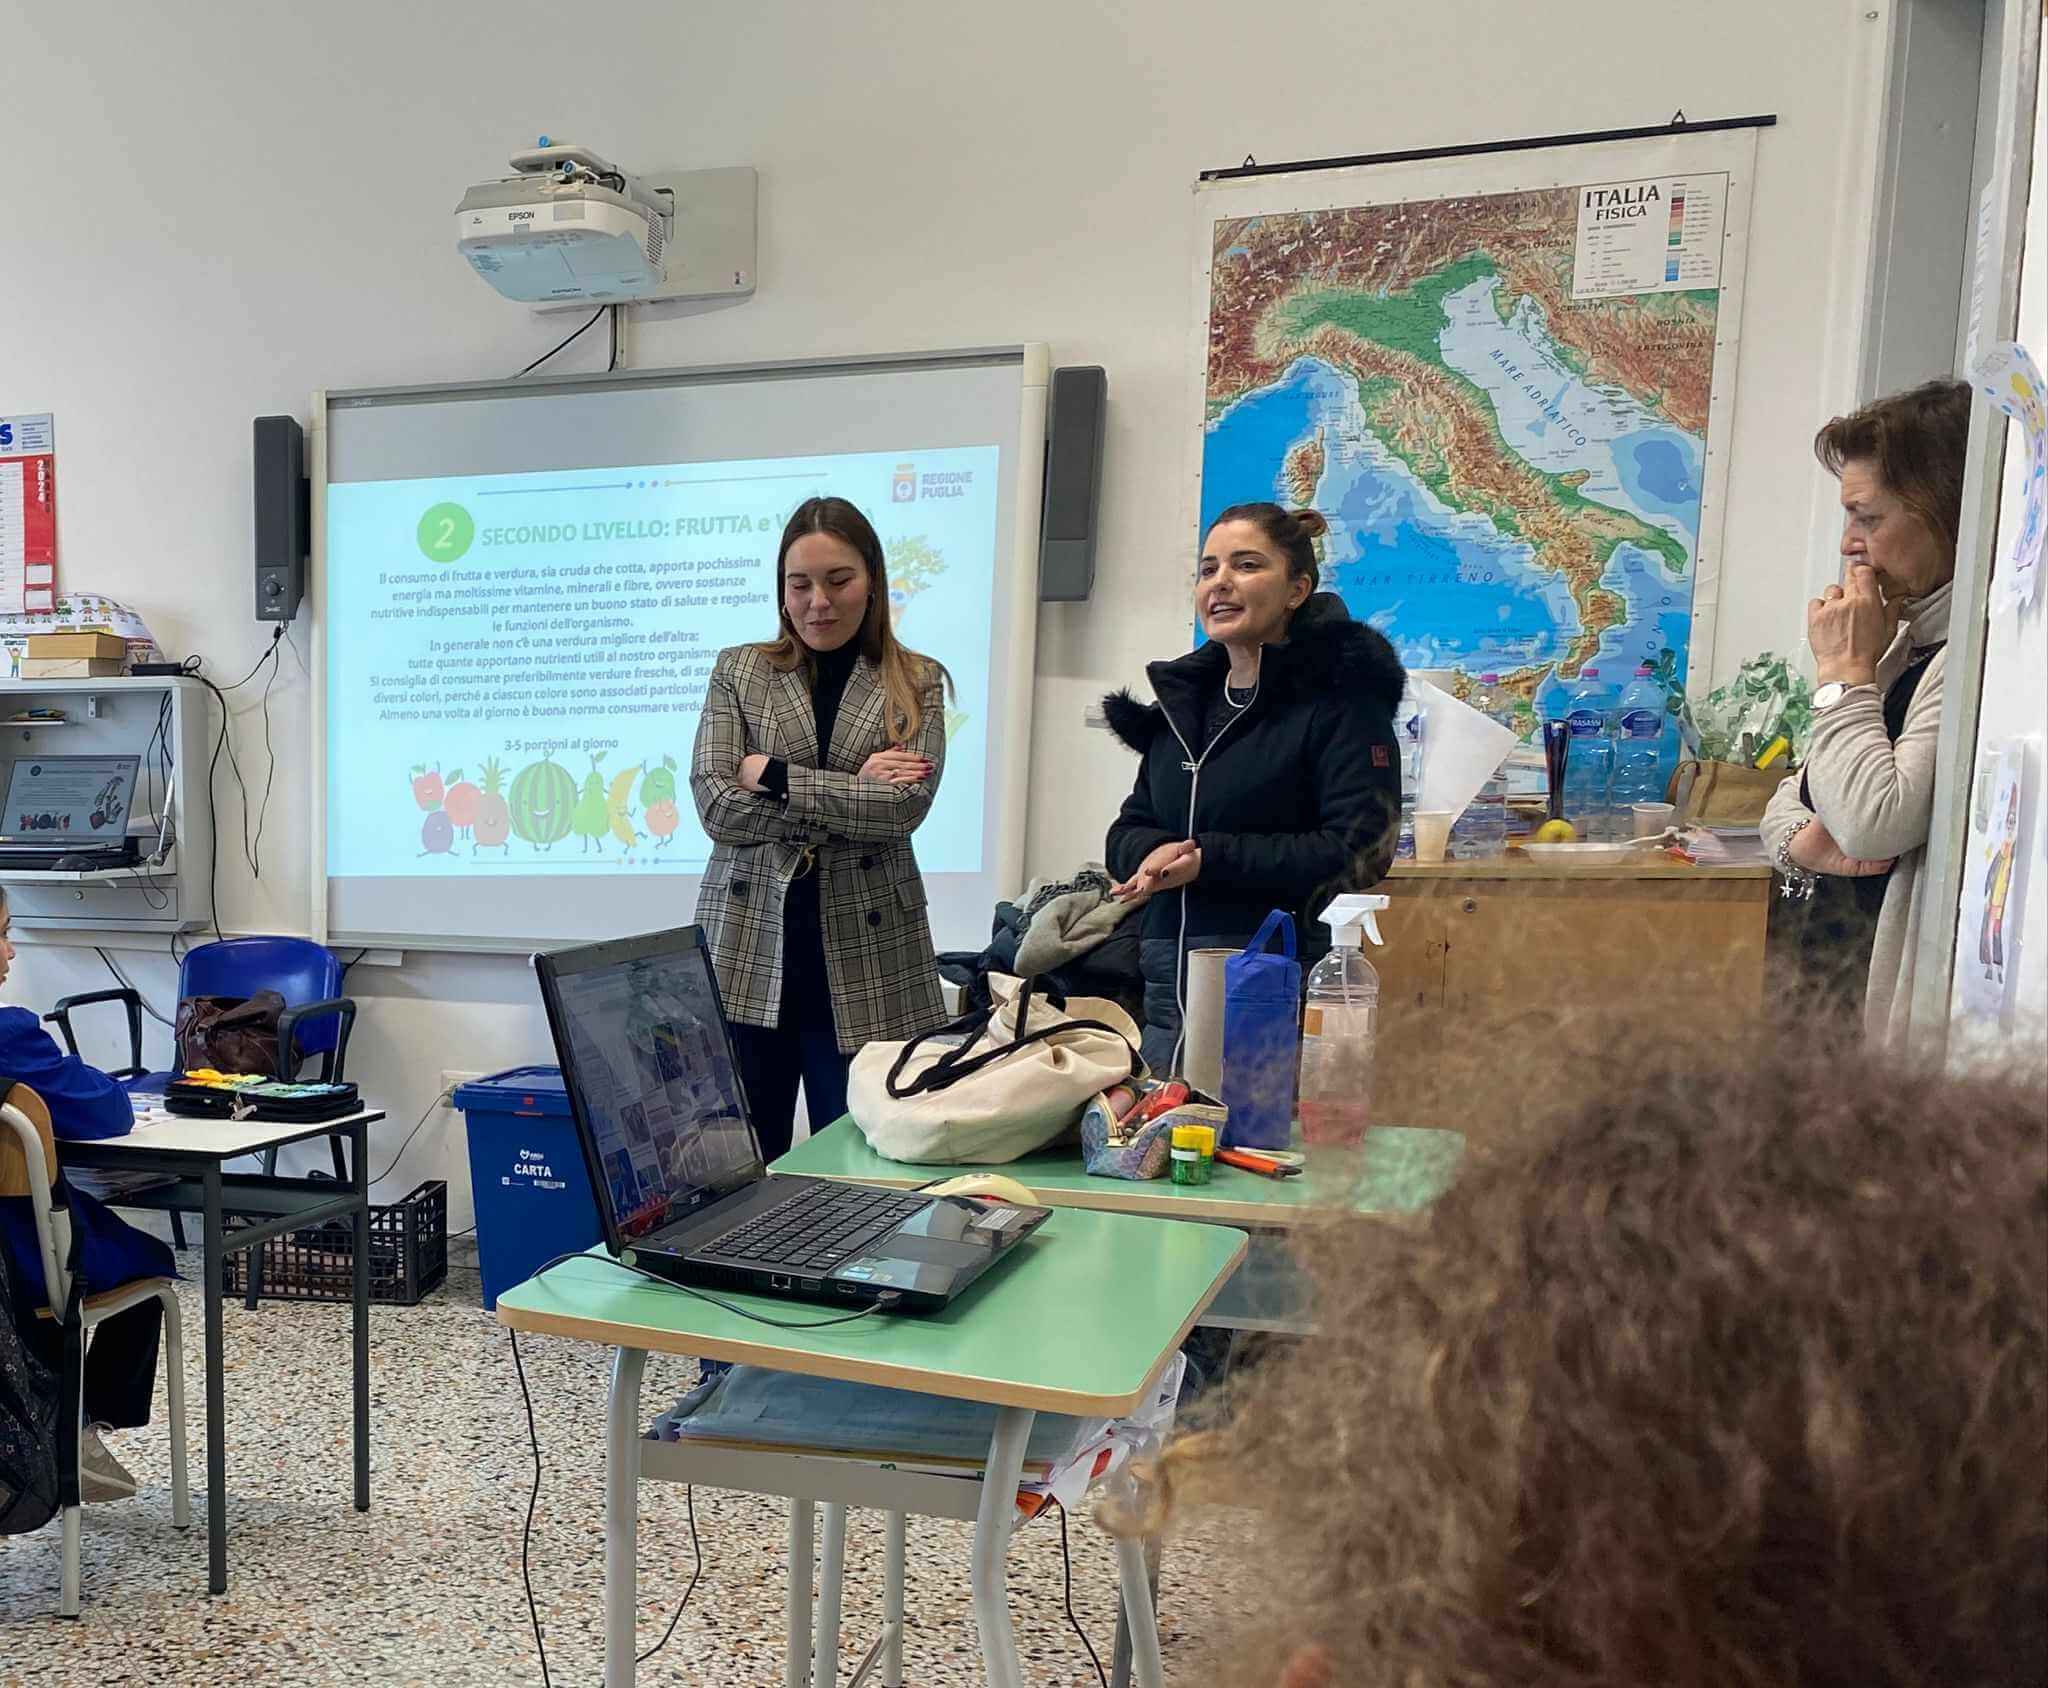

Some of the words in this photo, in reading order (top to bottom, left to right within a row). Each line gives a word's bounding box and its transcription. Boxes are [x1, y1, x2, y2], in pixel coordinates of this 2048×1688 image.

[1585, 185, 1660, 208] ITALIA
[508, 211, 535, 221] EPSON
[1596, 206, 1647, 221] FISICA
[1488, 349, 1525, 382] MARE
[1522, 384, 1587, 448] ADRIATICO
[922, 471, 973, 486] REGIONE
[921, 485, 964, 499] PUGLIA
[436, 518, 455, 548] 2
[481, 522, 577, 547] SECONDO
[583, 519, 669, 541] LIVELLO:
[675, 514, 753, 536] FRUTTA
[758, 518, 770, 532] e
[389, 573, 437, 584] consumo
[439, 571, 450, 582] di
[452, 570, 482, 582] frutta
[494, 568, 538, 580] verdura,
[541, 566, 557, 578] sia
[559, 564, 590, 576] cruda
[593, 563, 612, 575] che
[616, 562, 647, 575] cotta,
[649, 560, 694, 575] apporta
[697, 556, 761, 572] pochissima
[392, 590, 432, 602] energia
[434, 590, 452, 600] ma
[454, 585, 512, 598] moltissime
[514, 584, 564, 596] vitamine,
[567, 580, 612, 594] minerali
[624, 578, 652, 592] fibre,
[655, 578, 692, 590] ovvero
[696, 576, 746, 588] sostanze
[370, 605, 414, 618] nutritive
[416, 604, 489, 619] indispensabili
[491, 604, 510, 617] per
[512, 602, 572, 614] mantenere
[574, 601, 588, 612] un
[592, 599, 627, 610] buono
[630, 596, 658, 609] stato
[661, 594, 672, 608] di
[674, 593, 709, 606] salute
[720, 592, 769, 607] regolare
[493, 621, 502, 632] le
[505, 619, 548, 632] funzioni
[430, 640, 441, 652] In
[444, 638, 490, 653] generale
[493, 640, 514, 650] non
[532, 638, 553, 648] una
[555, 634, 598, 648] verdura
[601, 632, 646, 648] migliore
[408, 658, 434, 670] tutte
[436, 658, 474, 672] quante
[476, 656, 532, 670] apportano
[534, 652, 582, 666] nutrienti
[584, 650, 606, 663] utili
[607, 650, 617, 662] al
[620, 650, 655, 662] nostro
[370, 675, 380, 687] Si
[382, 675, 427, 688] consiglia
[429, 674, 440, 685] di
[442, 674, 500, 685] consumare
[503, 670, 586, 686] preferibilmente
[589, 667, 631, 680] verdure
[634, 666, 678, 680] fresche,
[680, 665, 692, 676] di
[374, 690, 408, 703] diversi
[444, 689, 480, 704] perché
[492, 690, 532, 701] ciascun
[534, 688, 568, 698] colore
[570, 686, 596, 698] sono
[600, 684, 648, 697] associati
[379, 709, 420, 720] Almeno
[422, 710, 442, 720] una
[444, 707, 470, 719] volta
[472, 706, 483, 718] al
[485, 706, 520, 720] giorno
[532, 705, 566, 716] buona
[569, 704, 605, 714] norma
[608, 702, 670, 714] consumare
[672, 701, 702, 712] verdu
[504, 739, 522, 751] 3-5
[524, 738, 568, 753] porzioni
[570, 738, 580, 750] al
[583, 737, 618, 752] giorno
[514, 1163, 552, 1177] CARTA
